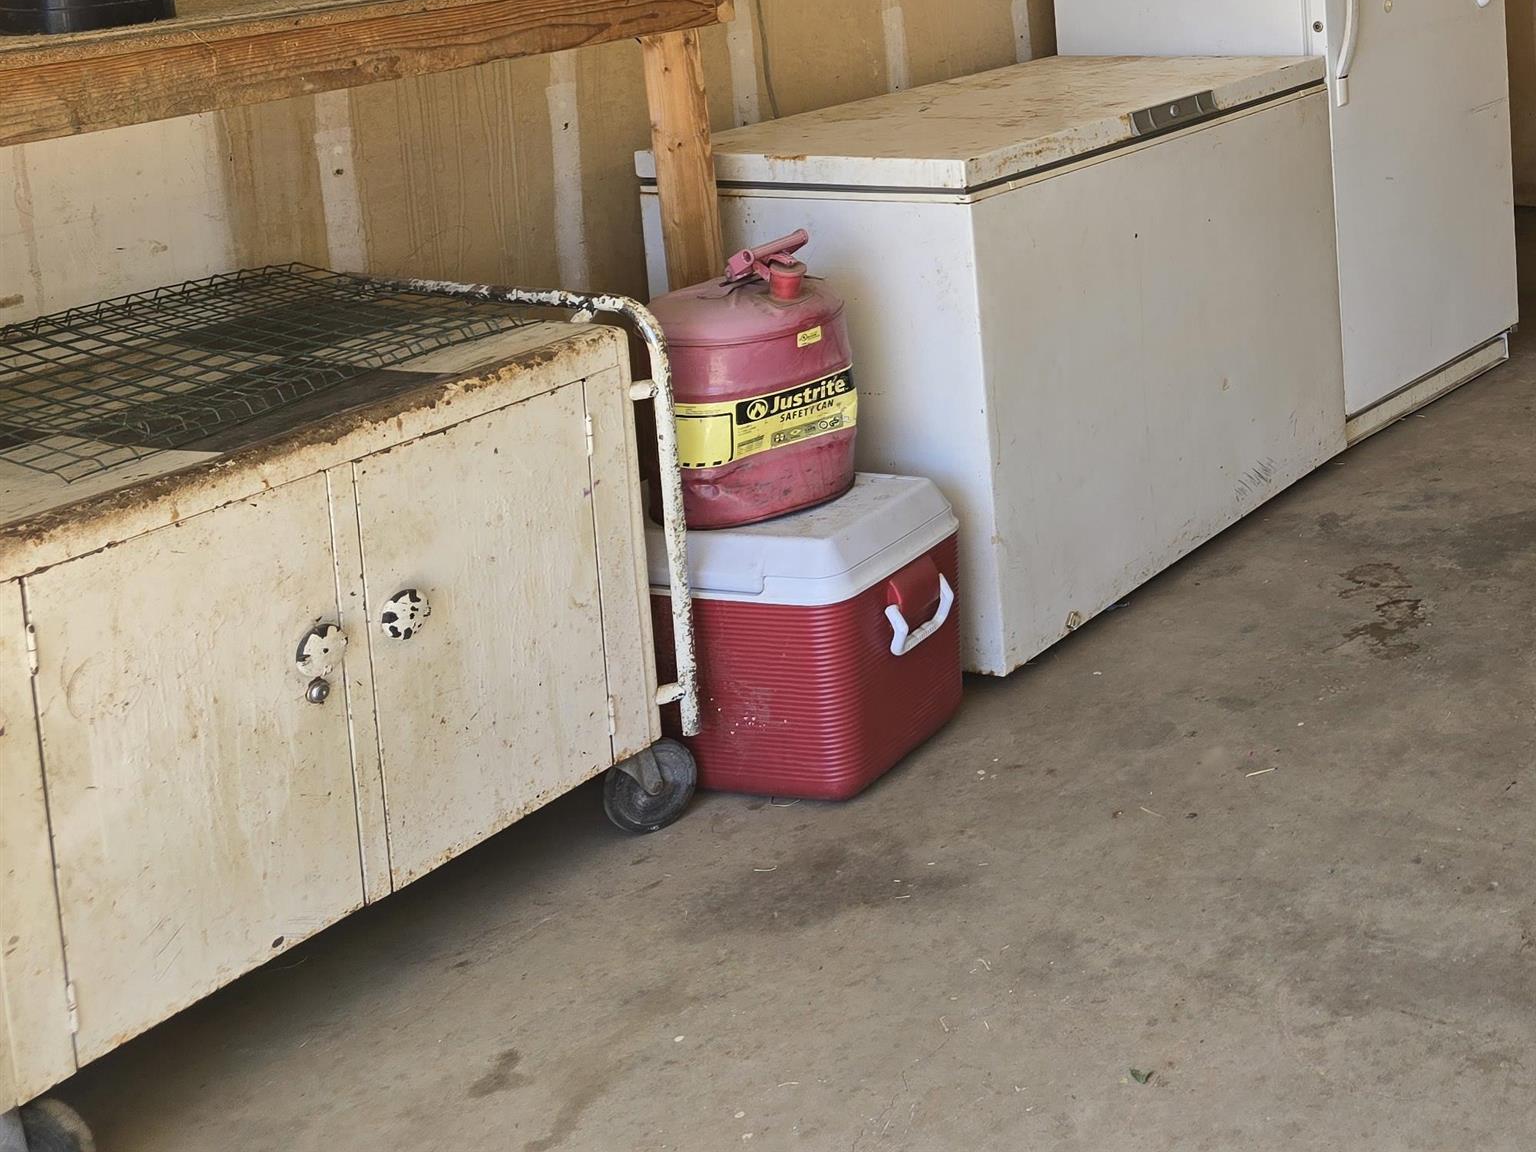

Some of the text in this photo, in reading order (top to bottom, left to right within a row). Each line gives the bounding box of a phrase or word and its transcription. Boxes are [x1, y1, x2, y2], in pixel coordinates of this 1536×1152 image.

[770, 375, 846, 414] Justrite
[780, 399, 834, 423] SAFETY CAN
